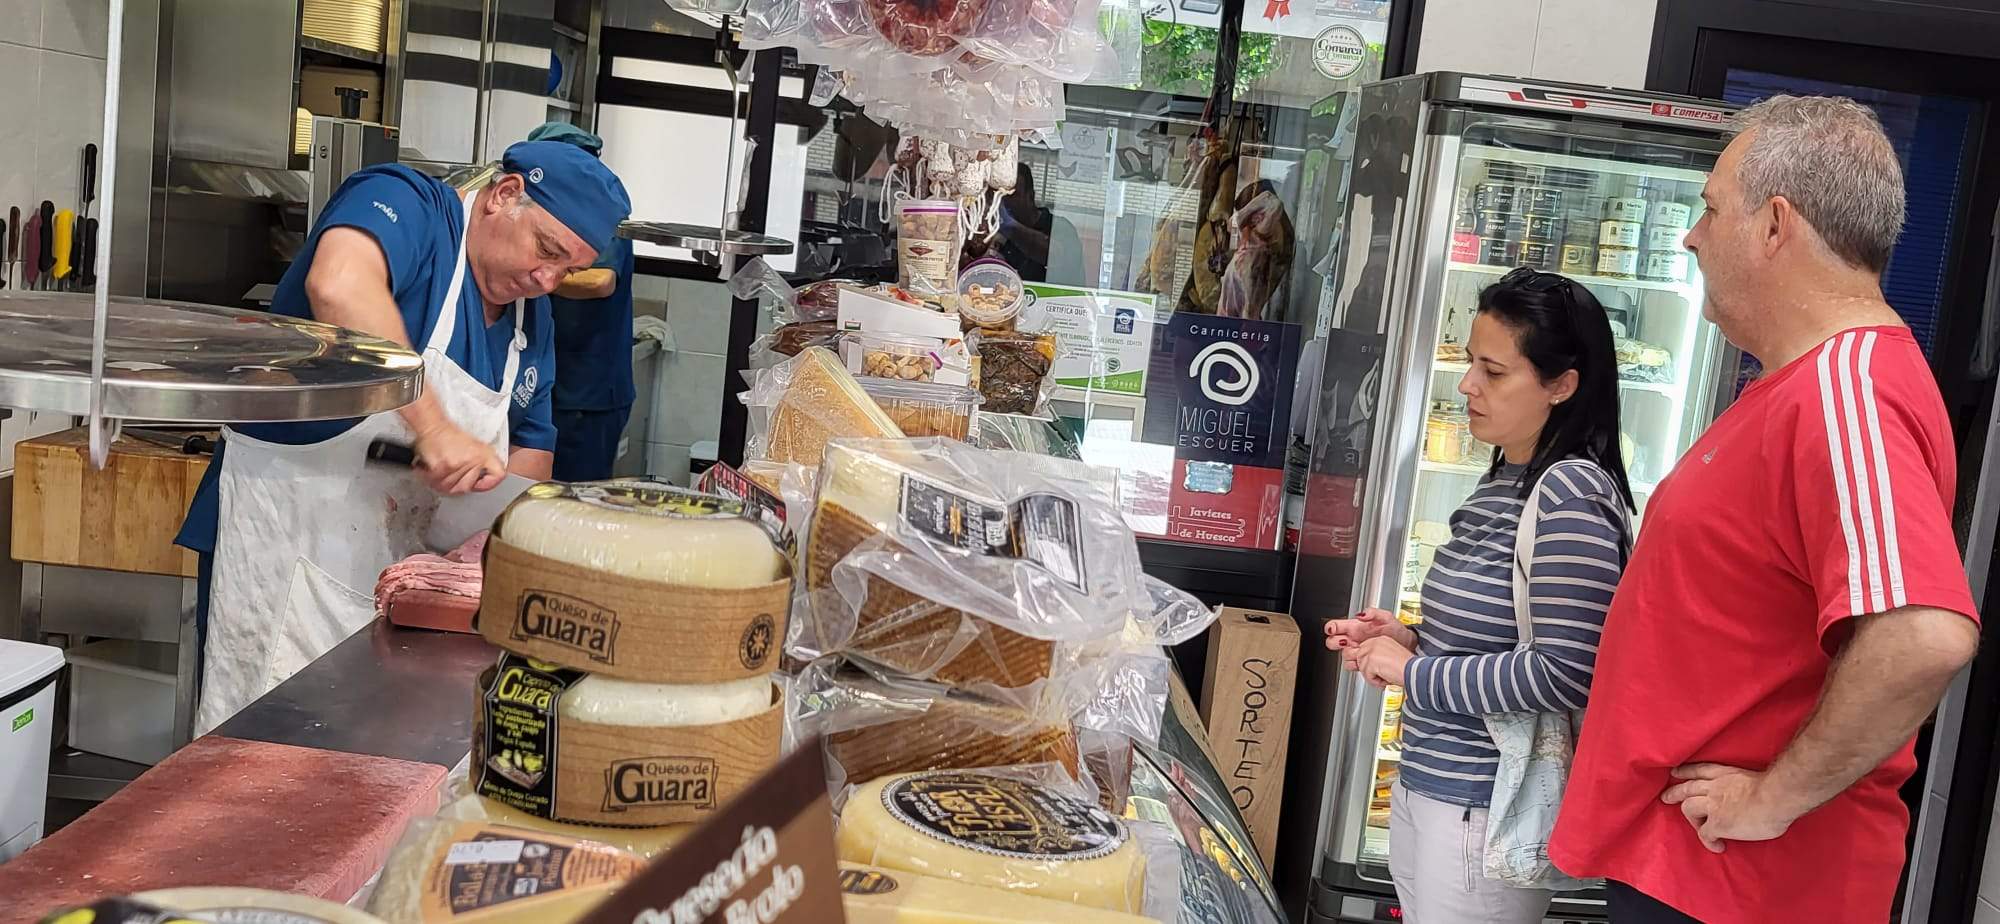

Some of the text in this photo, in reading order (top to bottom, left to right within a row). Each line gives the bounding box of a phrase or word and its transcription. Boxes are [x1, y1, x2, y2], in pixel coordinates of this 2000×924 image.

[1673, 108, 1719, 120] comersa
[1180, 406, 1256, 439] MIGUEL
[1178, 434, 1254, 453] ESCUER
[1180, 528, 1237, 543] de Huesca
[521, 593, 606, 652] Guara
[549, 597, 609, 626] Queso de
[498, 668, 551, 709] Guara
[1231, 658, 1274, 811] SORTEO
[613, 763, 708, 804] Guara
[646, 761, 710, 775] Queso de
